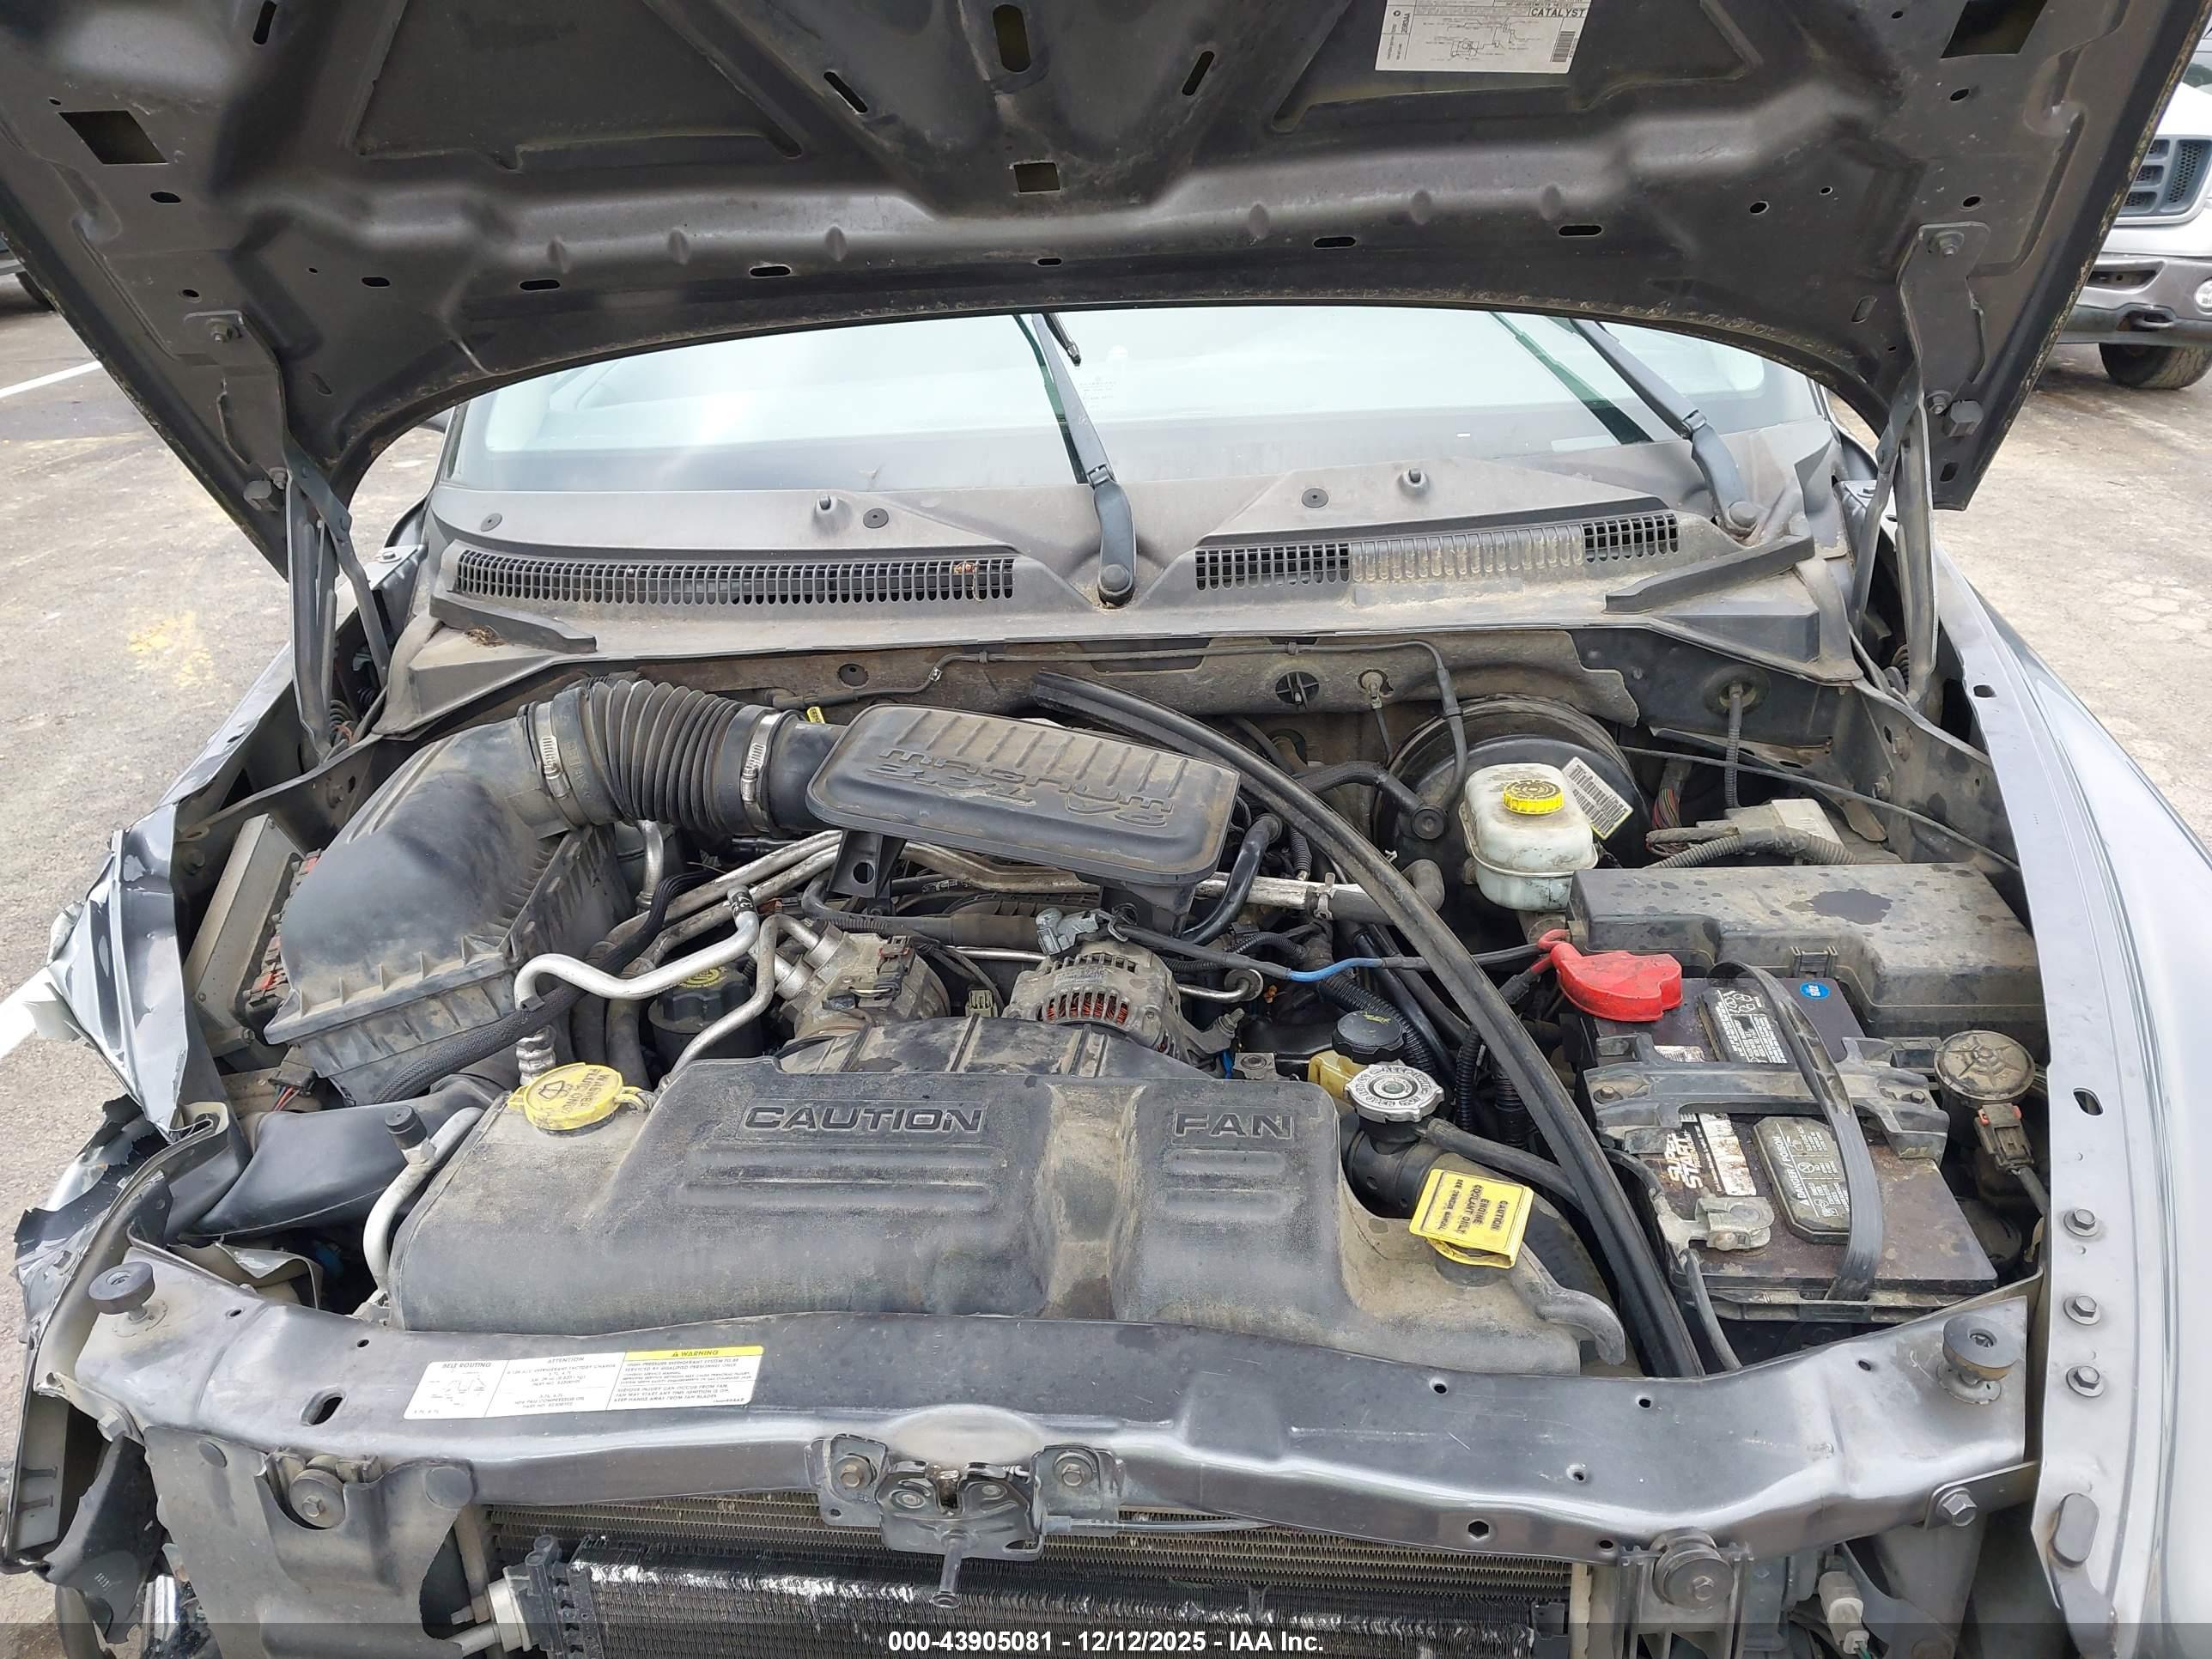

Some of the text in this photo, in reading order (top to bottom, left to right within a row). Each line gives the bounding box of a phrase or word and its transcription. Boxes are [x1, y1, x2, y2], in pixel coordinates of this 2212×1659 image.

[1531, 7, 1586, 17] CATALYST
[743, 1105, 1294, 1139] CAUTION FAN
[1671, 1133, 1703, 1188] START
[1772, 1136, 1791, 1162] POISON
[1786, 1169, 1808, 1199] DANGER
[1456, 1184, 1483, 1234] COOLANT ONLY
[1473, 1198, 1490, 1224] ENGINE
[1491, 1200, 1509, 1231] CAUTION
